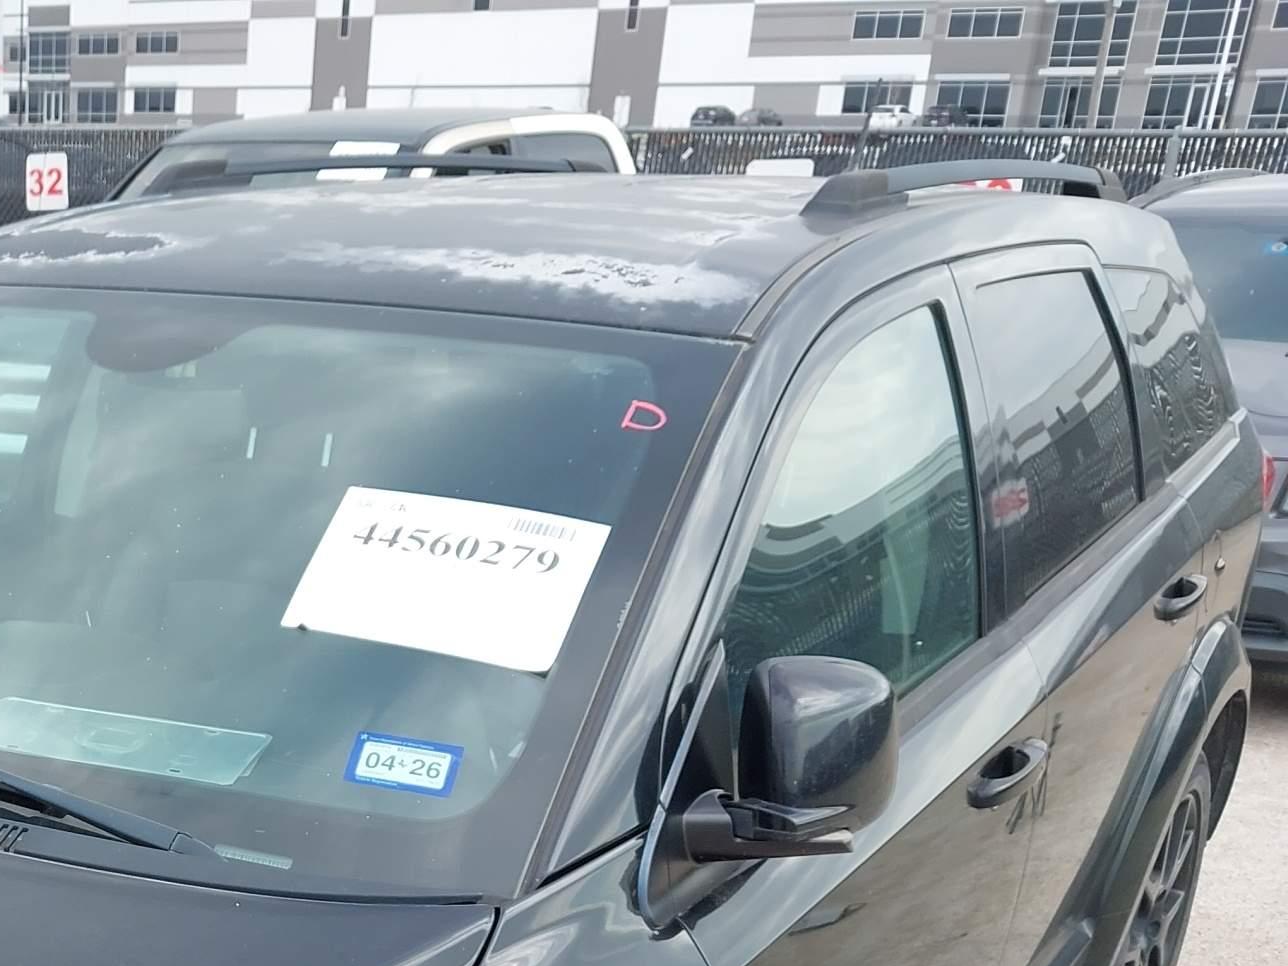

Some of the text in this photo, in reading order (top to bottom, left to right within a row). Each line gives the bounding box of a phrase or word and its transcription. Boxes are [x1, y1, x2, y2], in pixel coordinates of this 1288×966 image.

[28, 167, 64, 197] 32
[621, 399, 668, 431] D
[353, 521, 560, 574] 44560279
[365, 751, 397, 771] 04
[409, 759, 442, 779] 26
